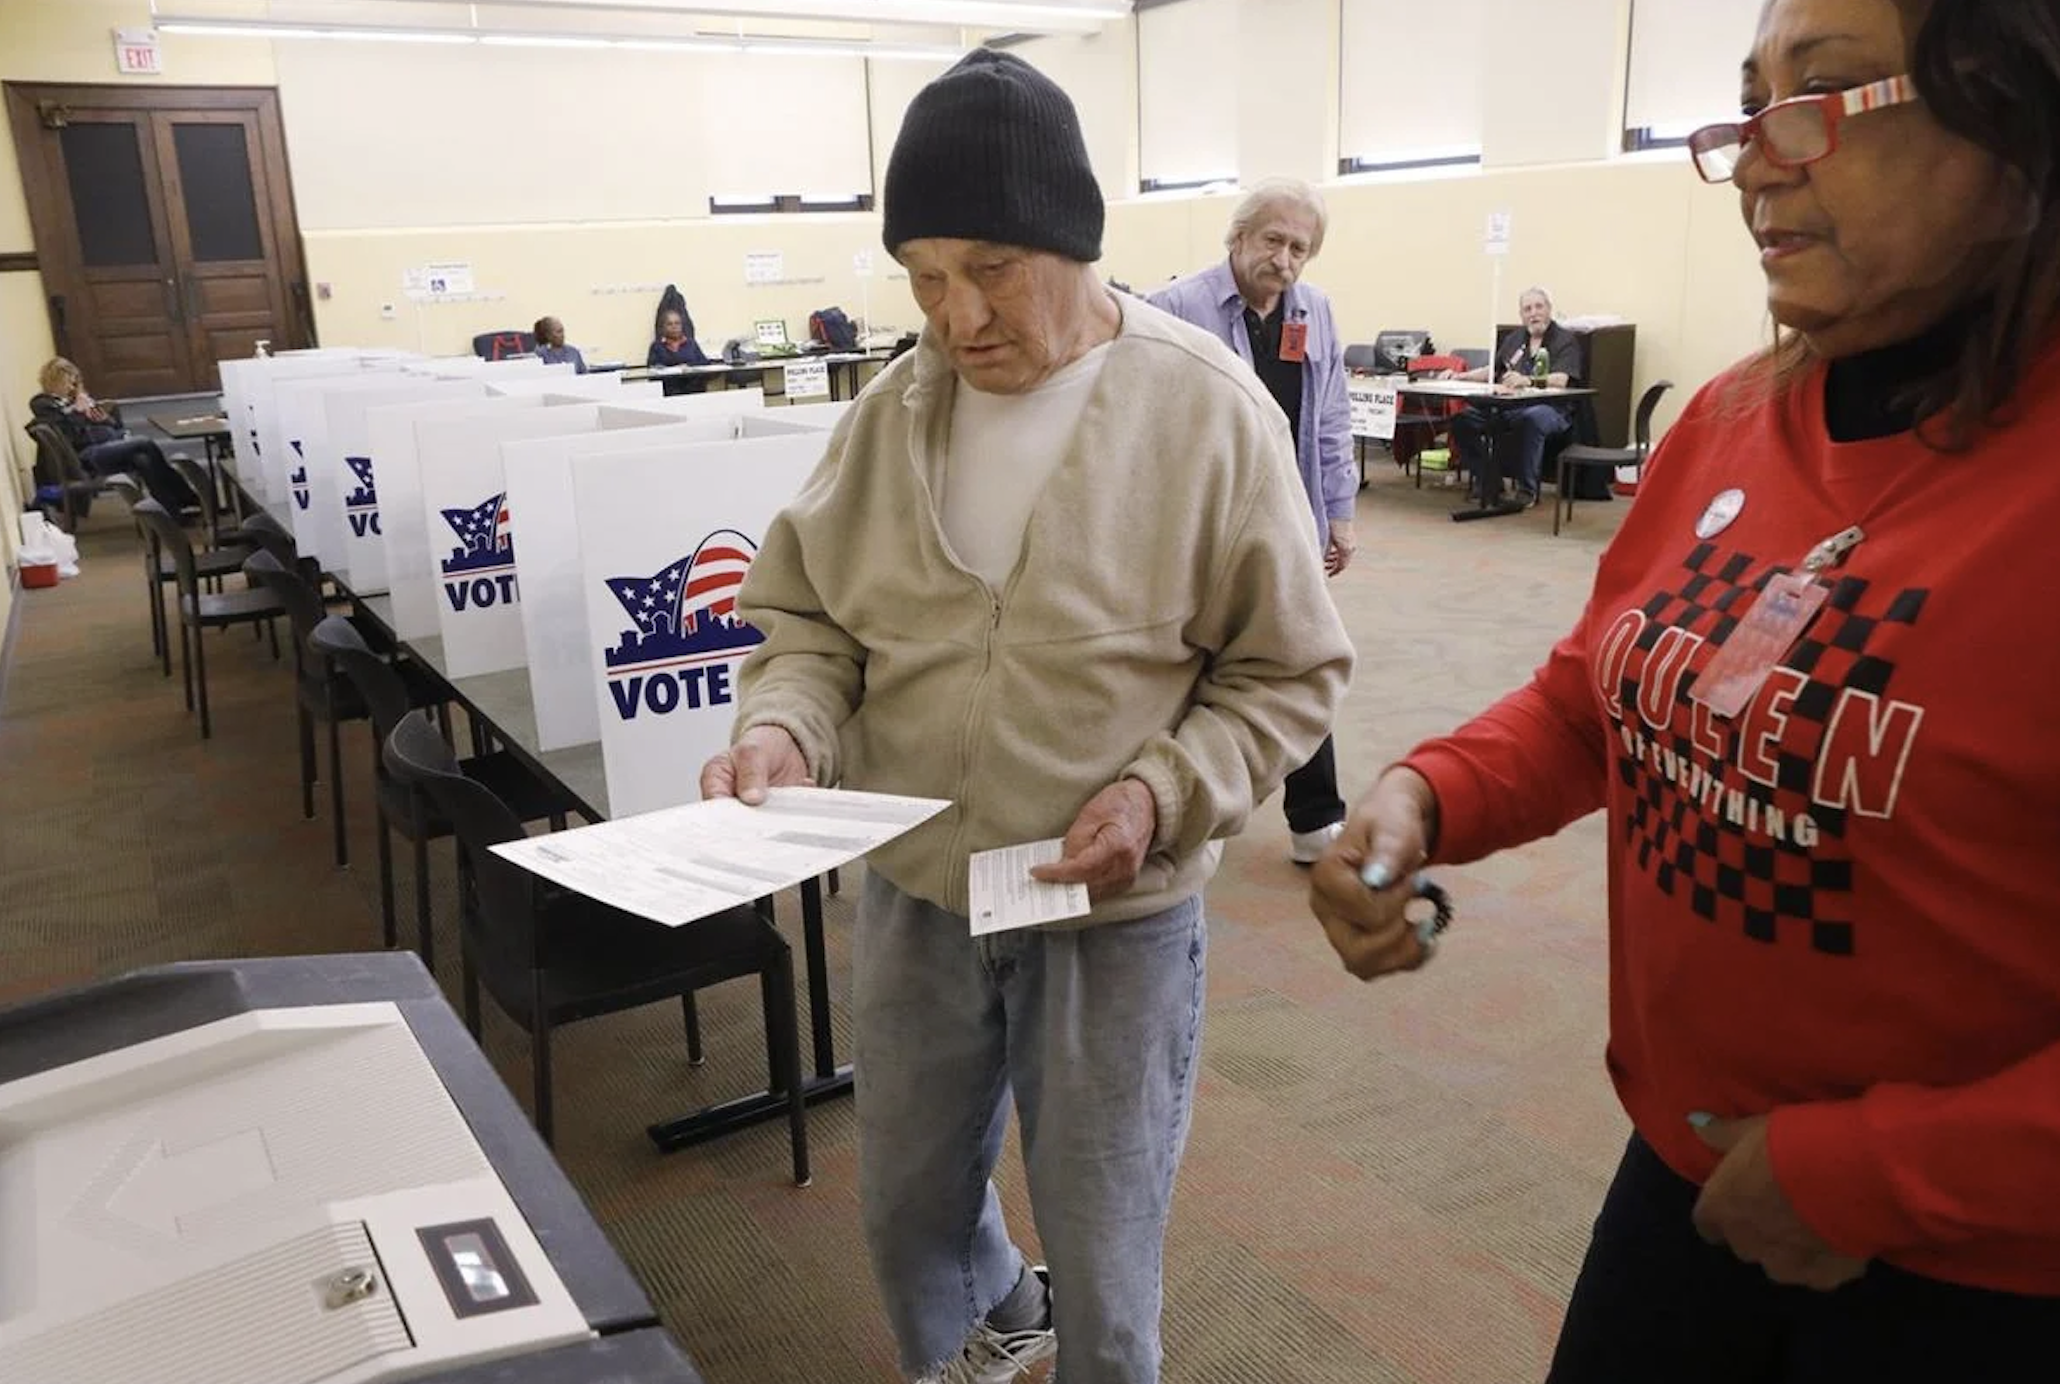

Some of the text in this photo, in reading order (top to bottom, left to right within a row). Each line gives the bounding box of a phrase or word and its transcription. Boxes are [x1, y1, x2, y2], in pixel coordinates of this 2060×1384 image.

[125, 48, 155, 69] EXIT
[1375, 393, 1394, 405] PLACE
[443, 573, 520, 612] VOT
[607, 663, 732, 720] VOTE
[1650, 740, 1820, 848] EVERYTHING
